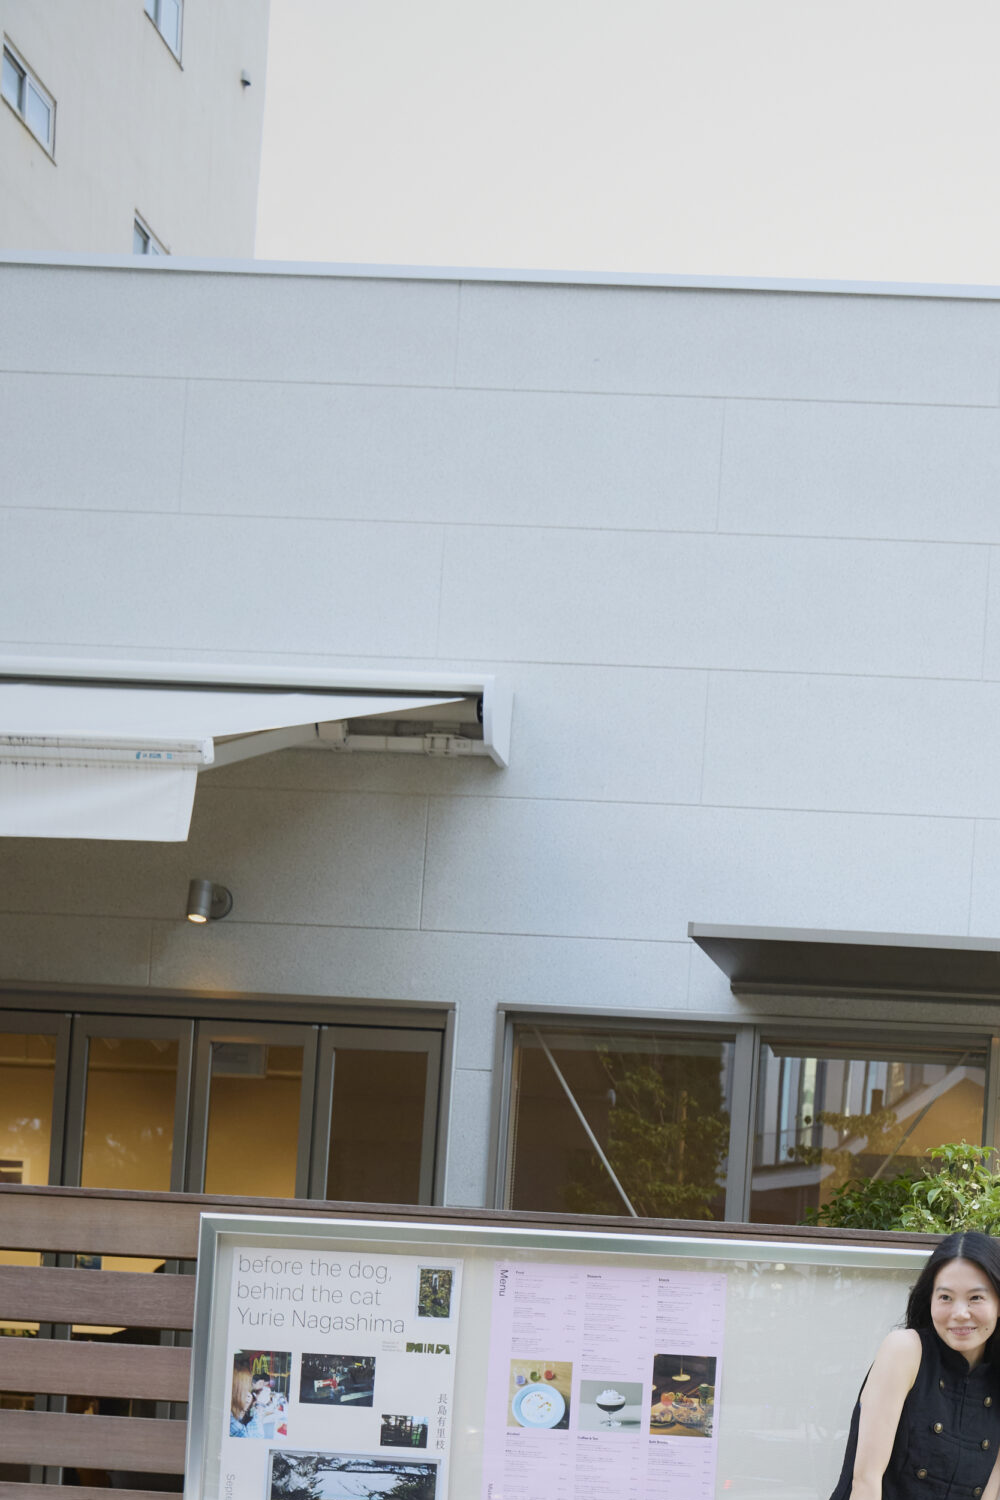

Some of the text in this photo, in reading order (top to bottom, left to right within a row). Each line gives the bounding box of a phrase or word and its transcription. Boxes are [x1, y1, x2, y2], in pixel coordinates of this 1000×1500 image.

[239, 1254, 392, 1284] before the dog,
[237, 1281, 382, 1306] behind the cat
[499, 1269, 509, 1297] Menu
[237, 1307, 405, 1334] Yurie Nagashima
